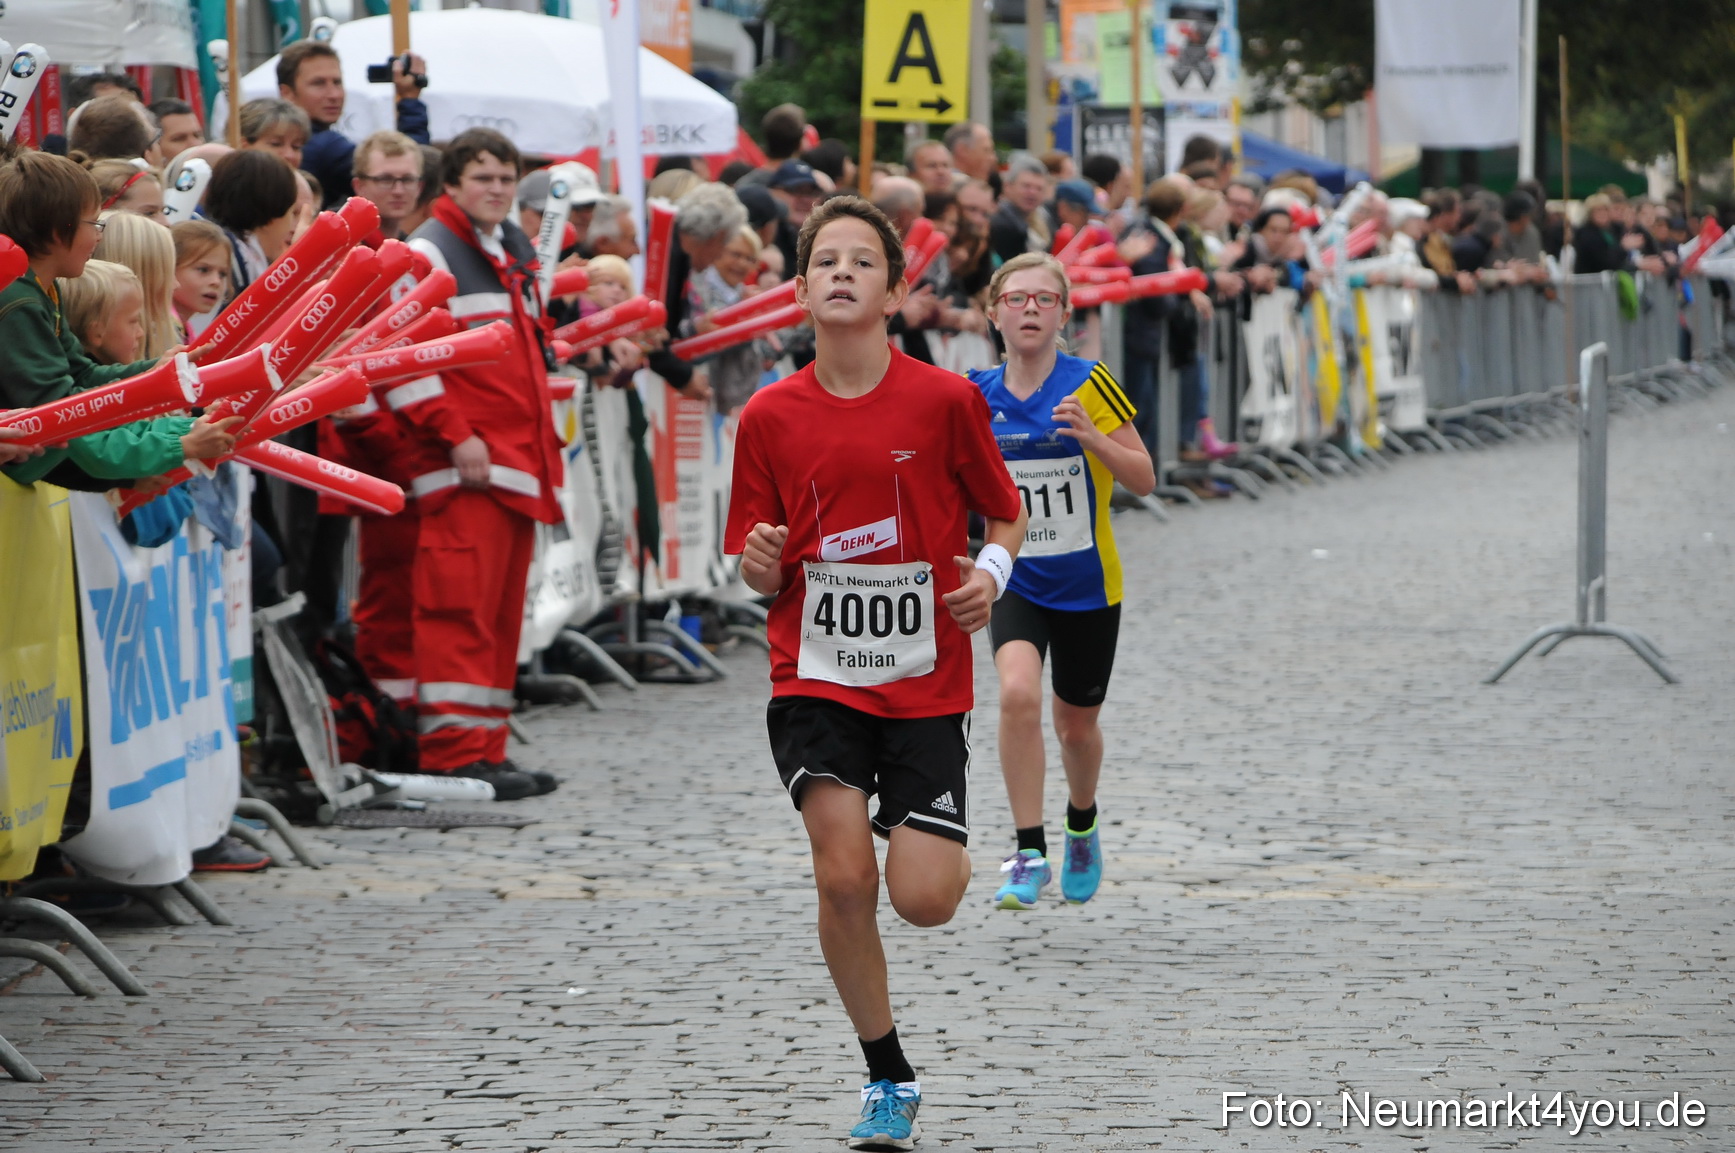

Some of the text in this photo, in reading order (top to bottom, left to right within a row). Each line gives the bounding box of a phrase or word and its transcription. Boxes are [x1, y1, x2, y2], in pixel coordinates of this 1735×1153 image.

[887, 13, 942, 84] A
[227, 296, 258, 328] BKK
[366, 354, 400, 370] BKK
[54, 389, 125, 425] Audi BKK
[268, 443, 303, 462] BKK
[1016, 469, 1065, 480] Neumarkt
[1018, 481, 1074, 519] 011
[840, 532, 876, 552] DEHN
[1026, 528, 1057, 542] erle
[807, 570, 909, 588] PARTL Neumarkt
[813, 592, 922, 638] 4000
[837, 650, 896, 668] Fabian
[931, 801, 958, 815] adidas
